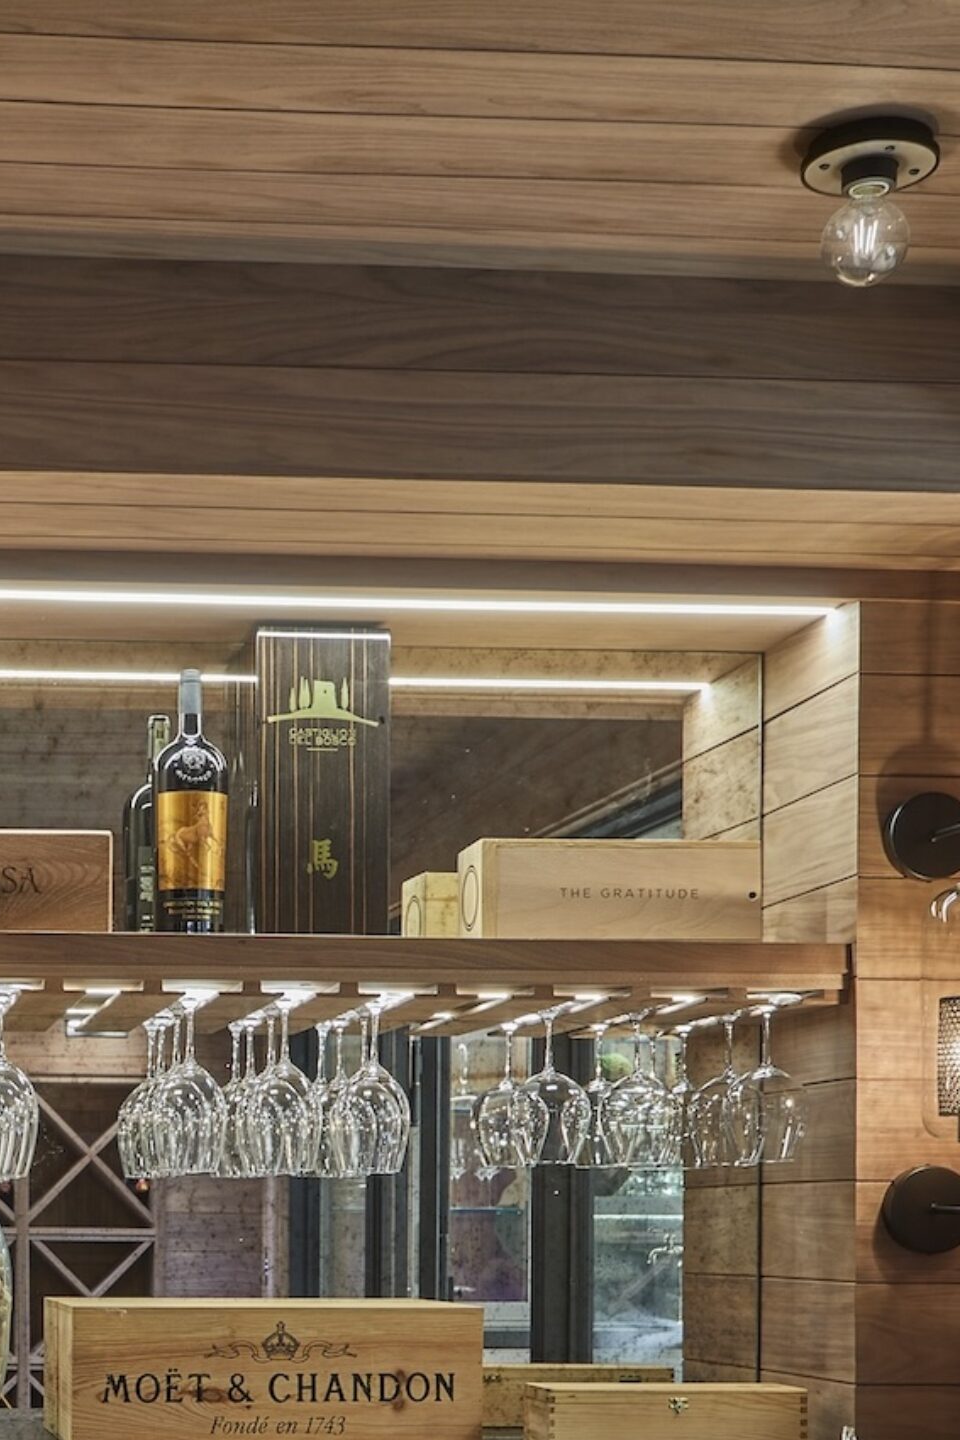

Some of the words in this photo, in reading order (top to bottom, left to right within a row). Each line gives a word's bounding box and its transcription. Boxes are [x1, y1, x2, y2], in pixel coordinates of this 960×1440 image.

[315, 736, 357, 746] BOSCO
[306, 839, 339, 881] 馬
[559, 887, 591, 899] THE
[600, 887, 700, 900] GRATITUDE
[100, 1368, 211, 1404] MOËT
[227, 1372, 254, 1403] &
[268, 1372, 456, 1404] CHANDON
[209, 1415, 268, 1435] Fondé
[275, 1420, 298, 1434] en
[304, 1416, 346, 1436] 1743
